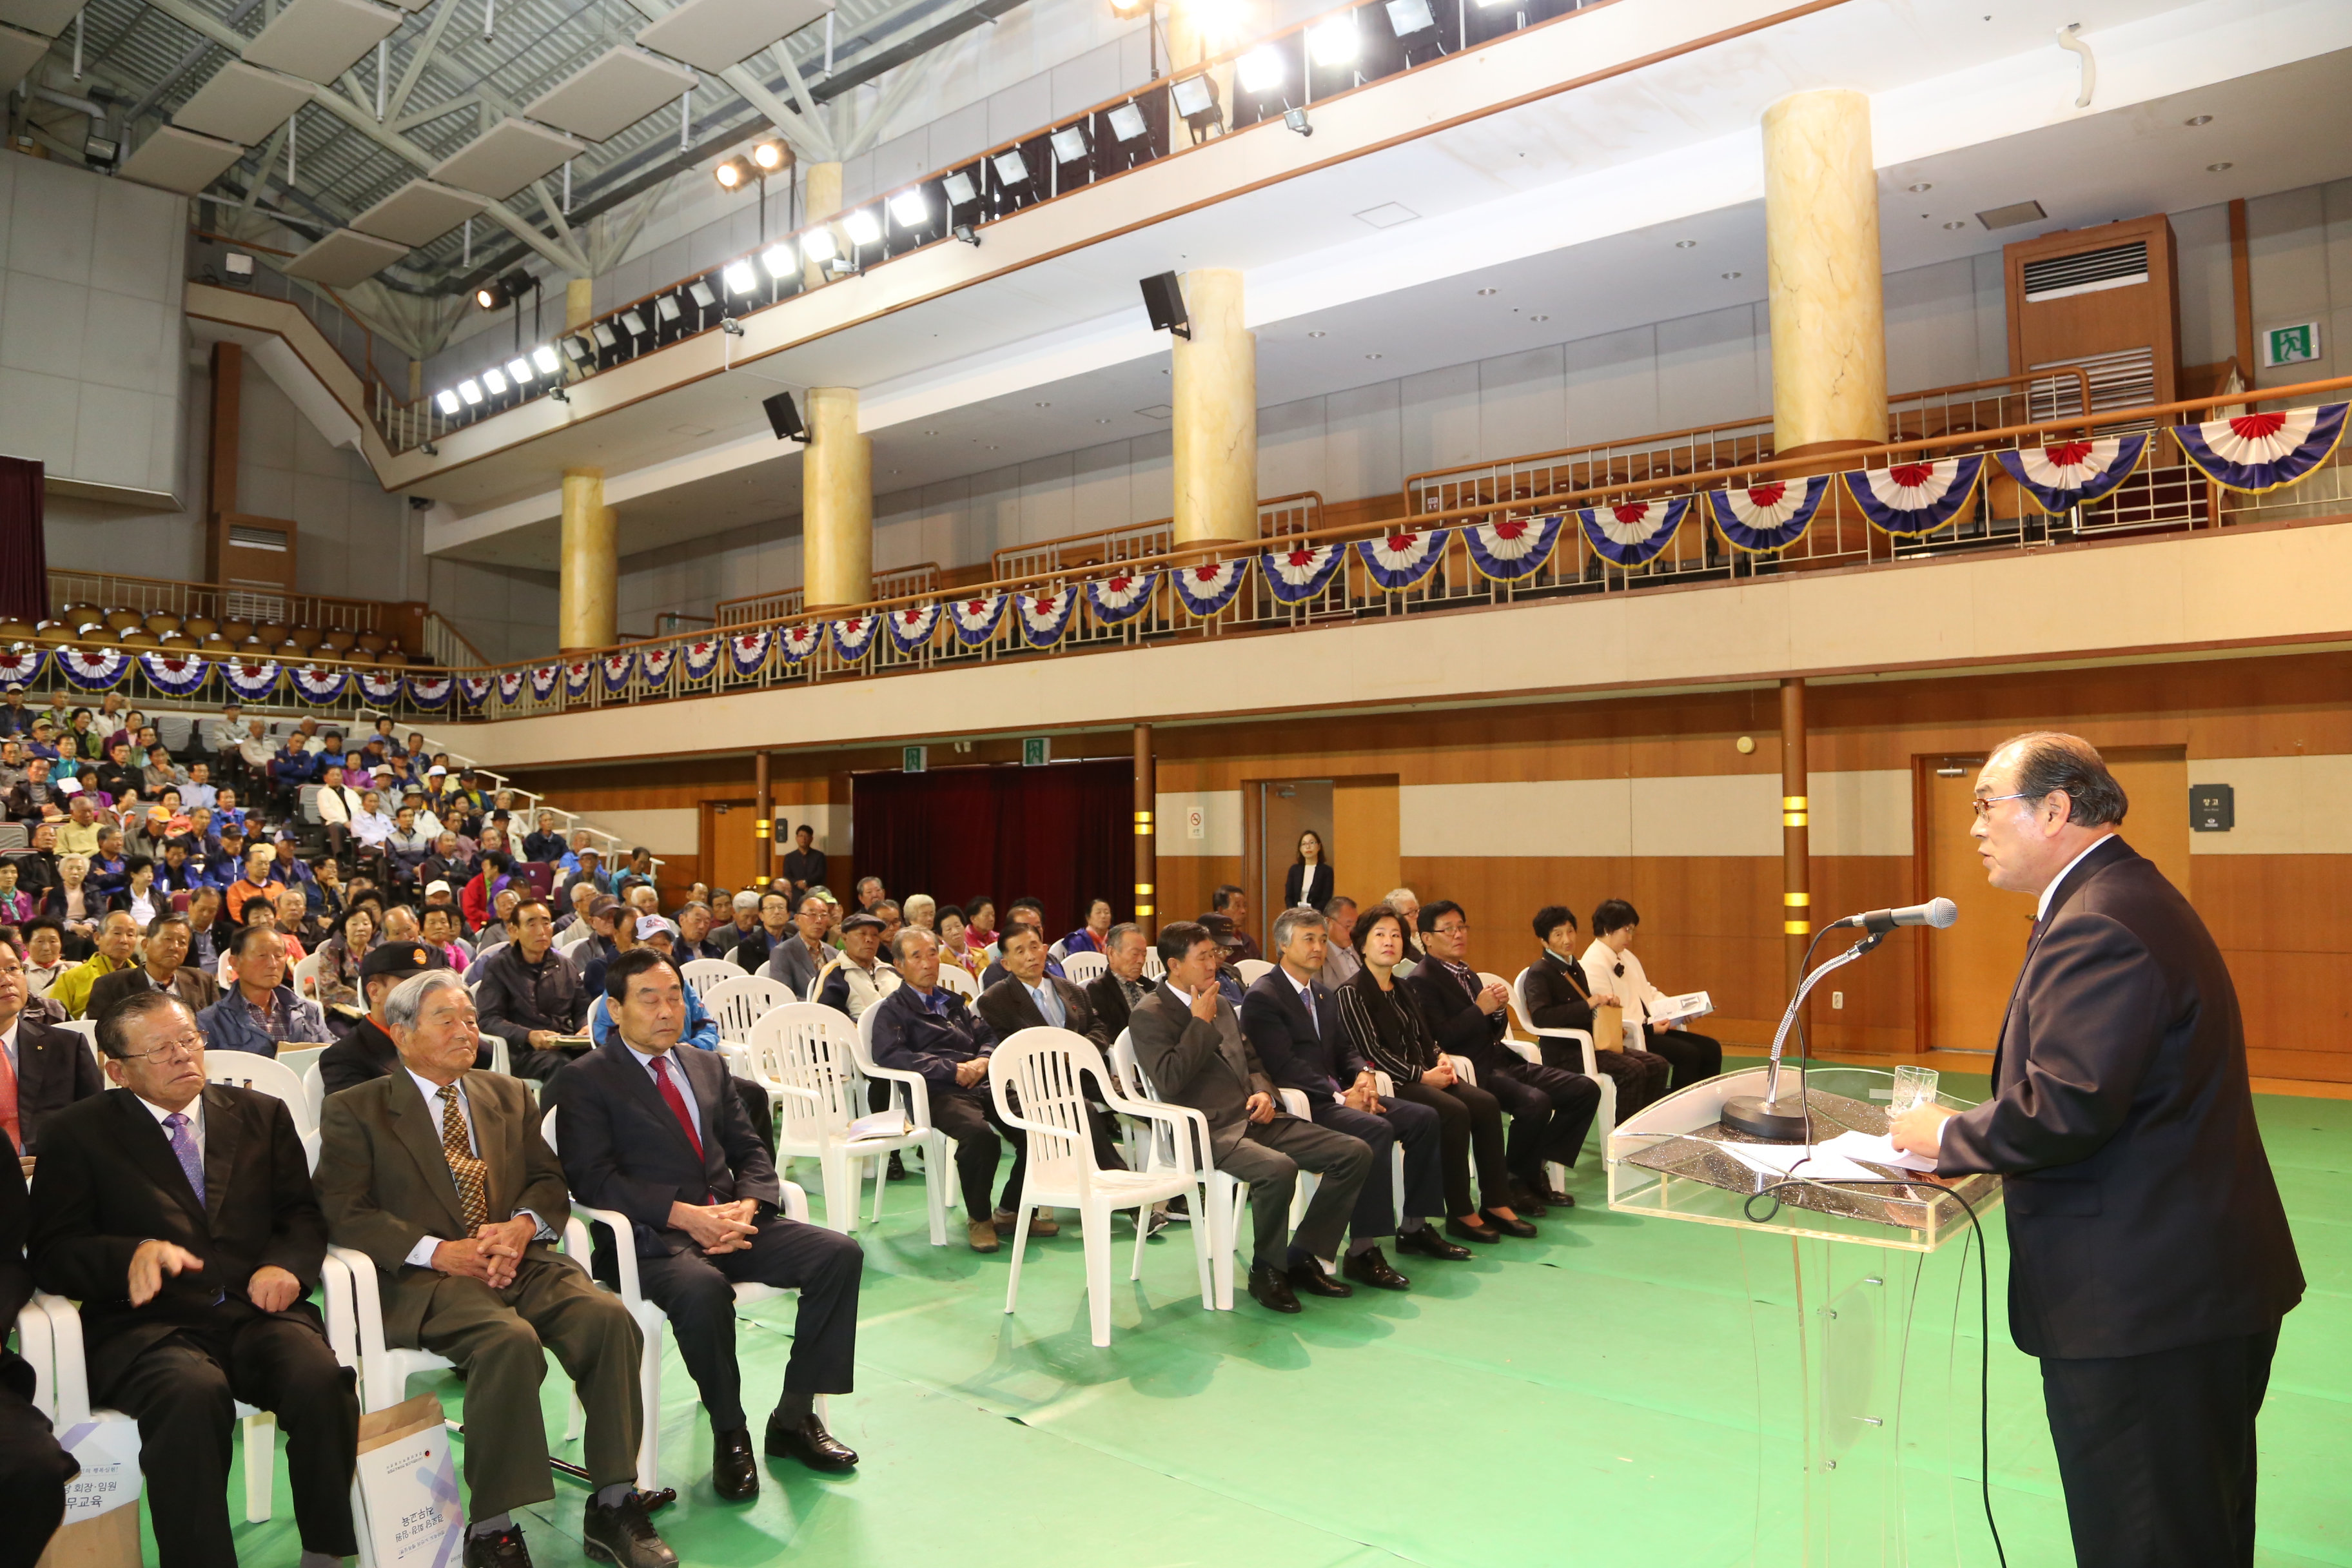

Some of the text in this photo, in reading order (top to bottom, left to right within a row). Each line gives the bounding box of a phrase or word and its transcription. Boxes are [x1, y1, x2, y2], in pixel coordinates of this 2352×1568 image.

[74, 1481, 117, 1493] 회장·임원
[65, 1495, 103, 1509] 무교육
[402, 1506, 435, 1527] 직무교육
[395, 1513, 444, 1543] 경로당 회장·임원
